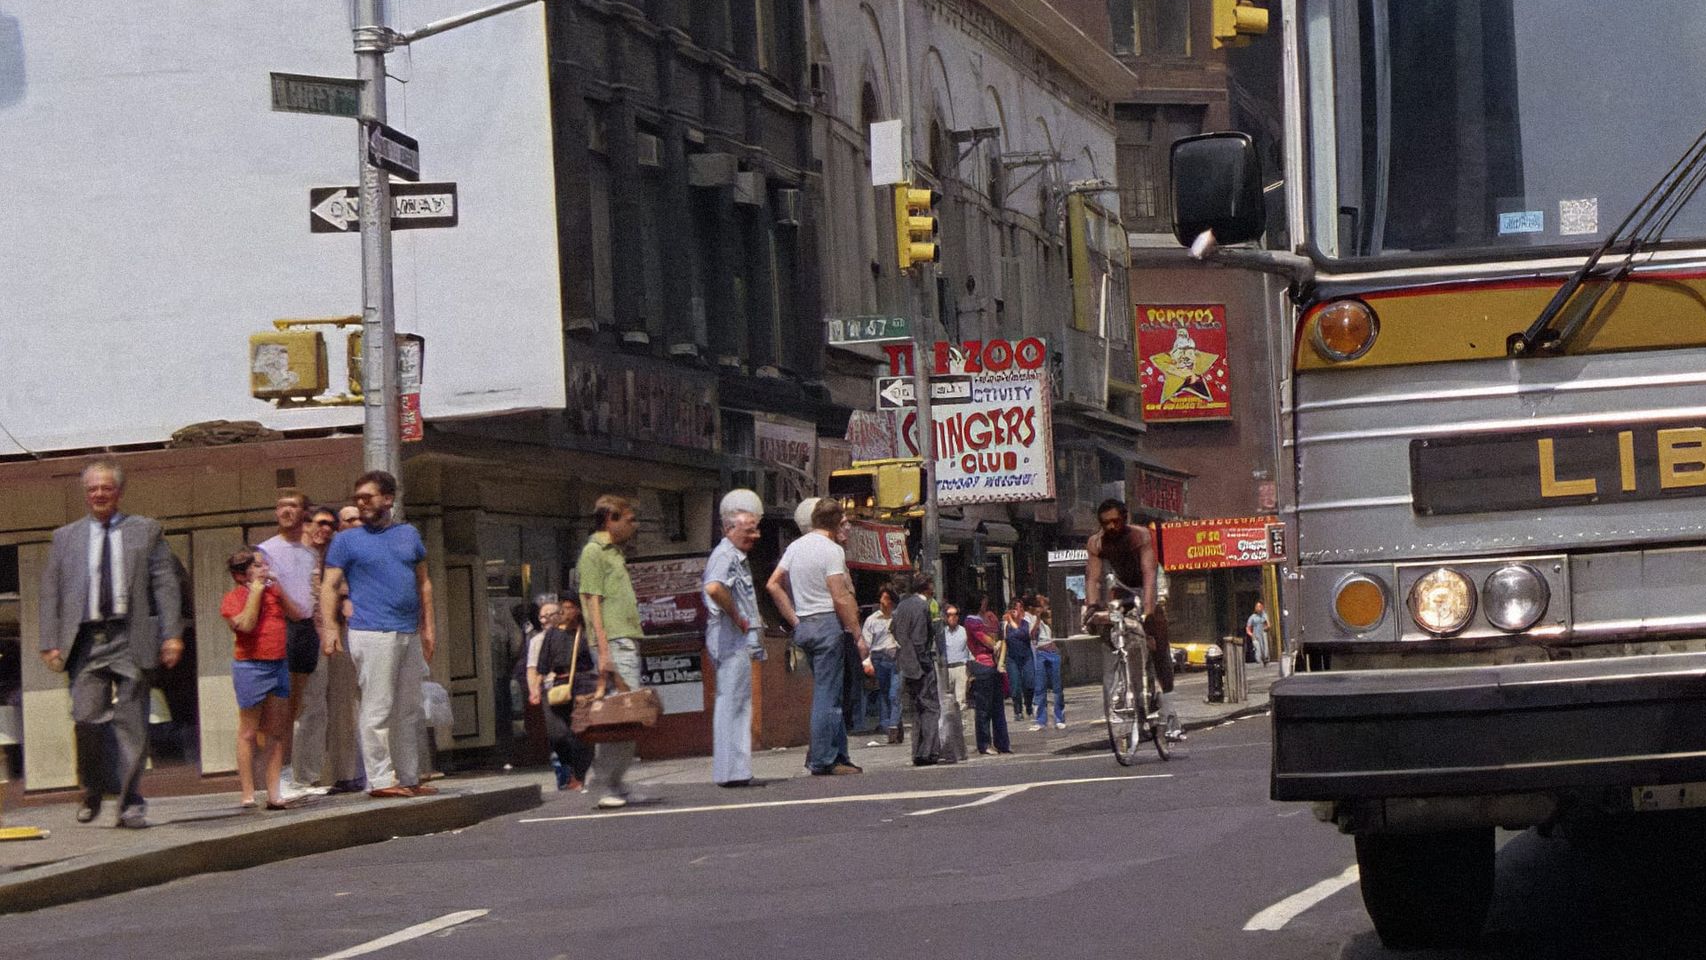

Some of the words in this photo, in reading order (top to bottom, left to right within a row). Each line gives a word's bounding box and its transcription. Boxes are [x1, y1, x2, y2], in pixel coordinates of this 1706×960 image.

[962, 336, 1045, 374] ZOO
[901, 405, 1037, 462] SINGERS
[960, 450, 1018, 474] CLUB
